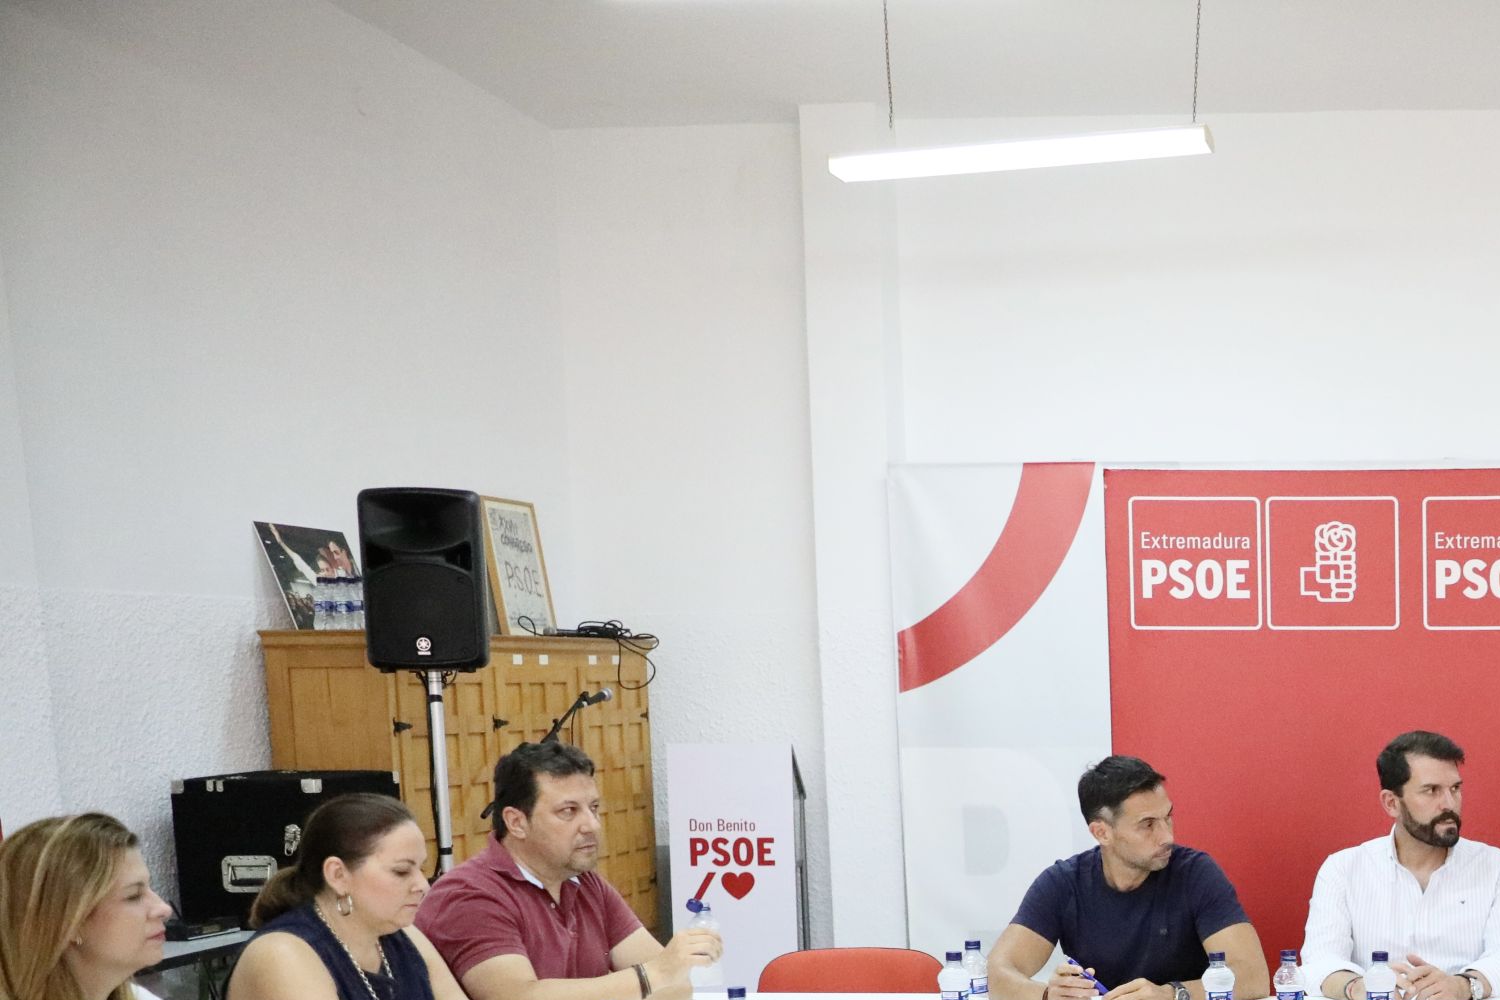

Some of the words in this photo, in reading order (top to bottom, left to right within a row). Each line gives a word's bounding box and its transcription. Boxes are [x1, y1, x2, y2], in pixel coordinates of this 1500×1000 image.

[1140, 530, 1251, 550] Extremadura
[1140, 557, 1251, 600] PSOE
[689, 818, 713, 832] Don
[717, 818, 756, 832] Benito
[689, 837, 775, 867] PSOE
